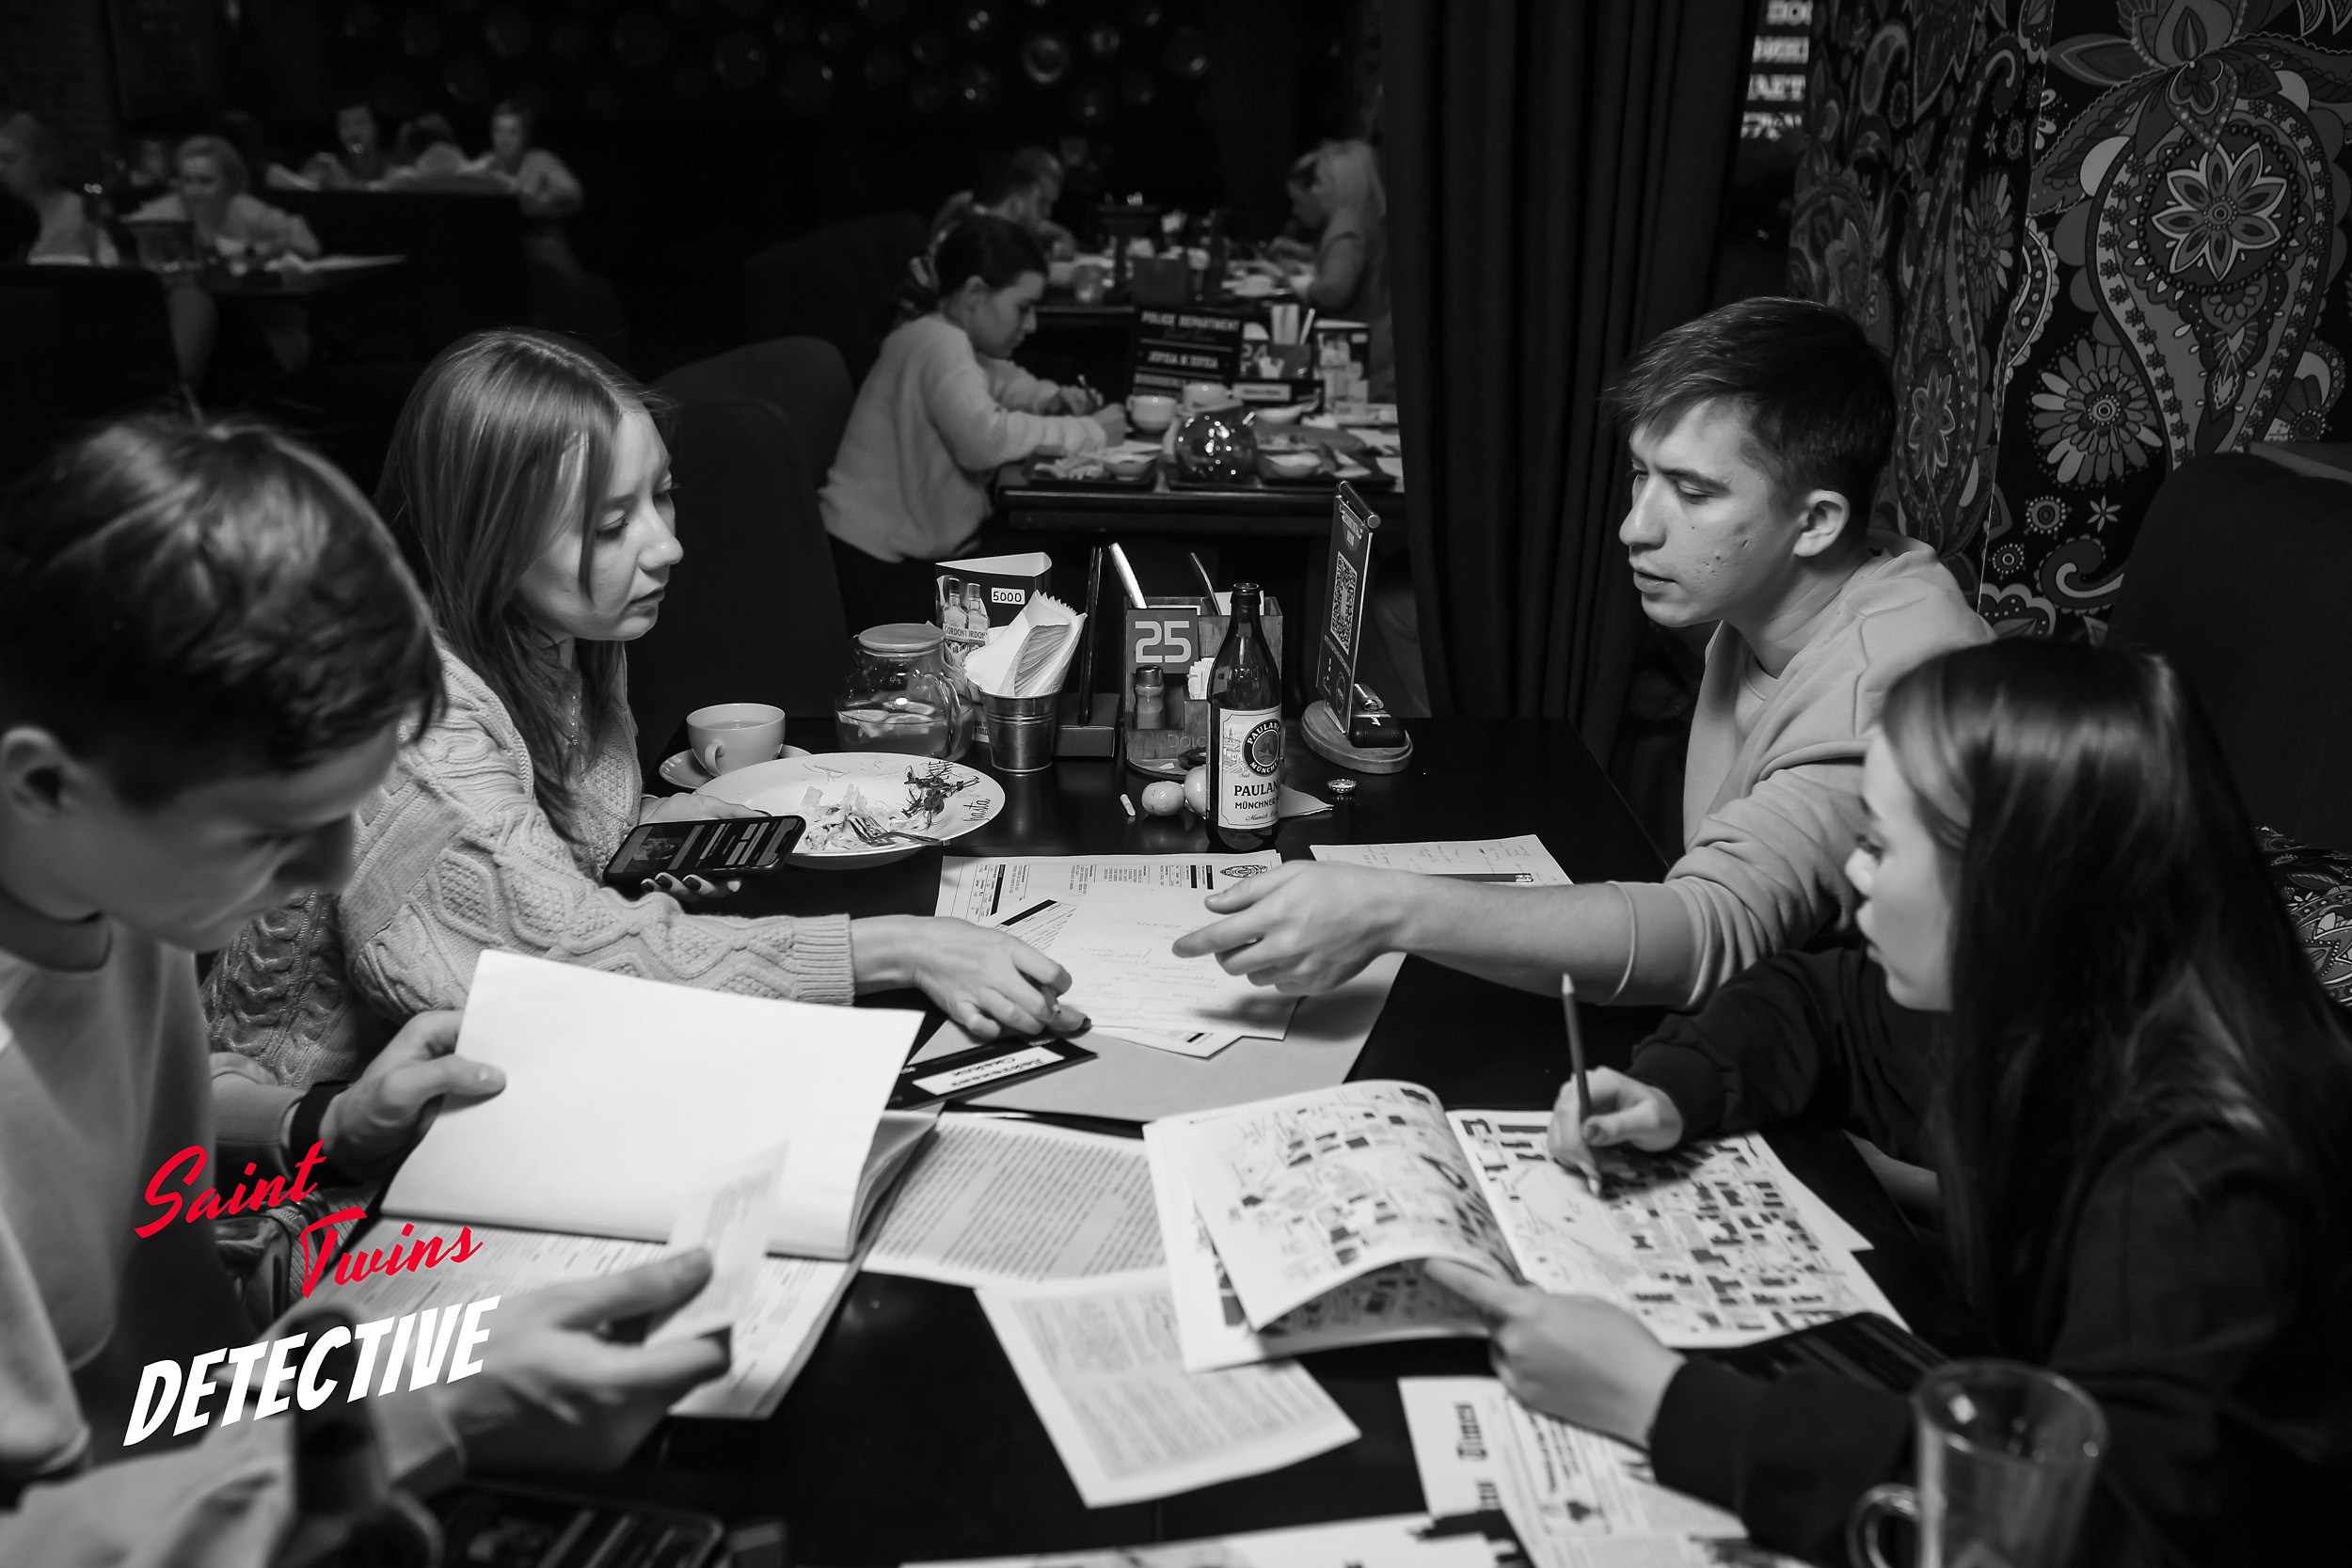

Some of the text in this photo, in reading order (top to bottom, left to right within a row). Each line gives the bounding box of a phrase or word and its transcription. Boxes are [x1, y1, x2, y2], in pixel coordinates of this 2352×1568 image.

[1141, 311, 1241, 332] POLICE DEPARTMENT
[993, 591, 1022, 603] 5000
[1135, 620, 1192, 663] 25
